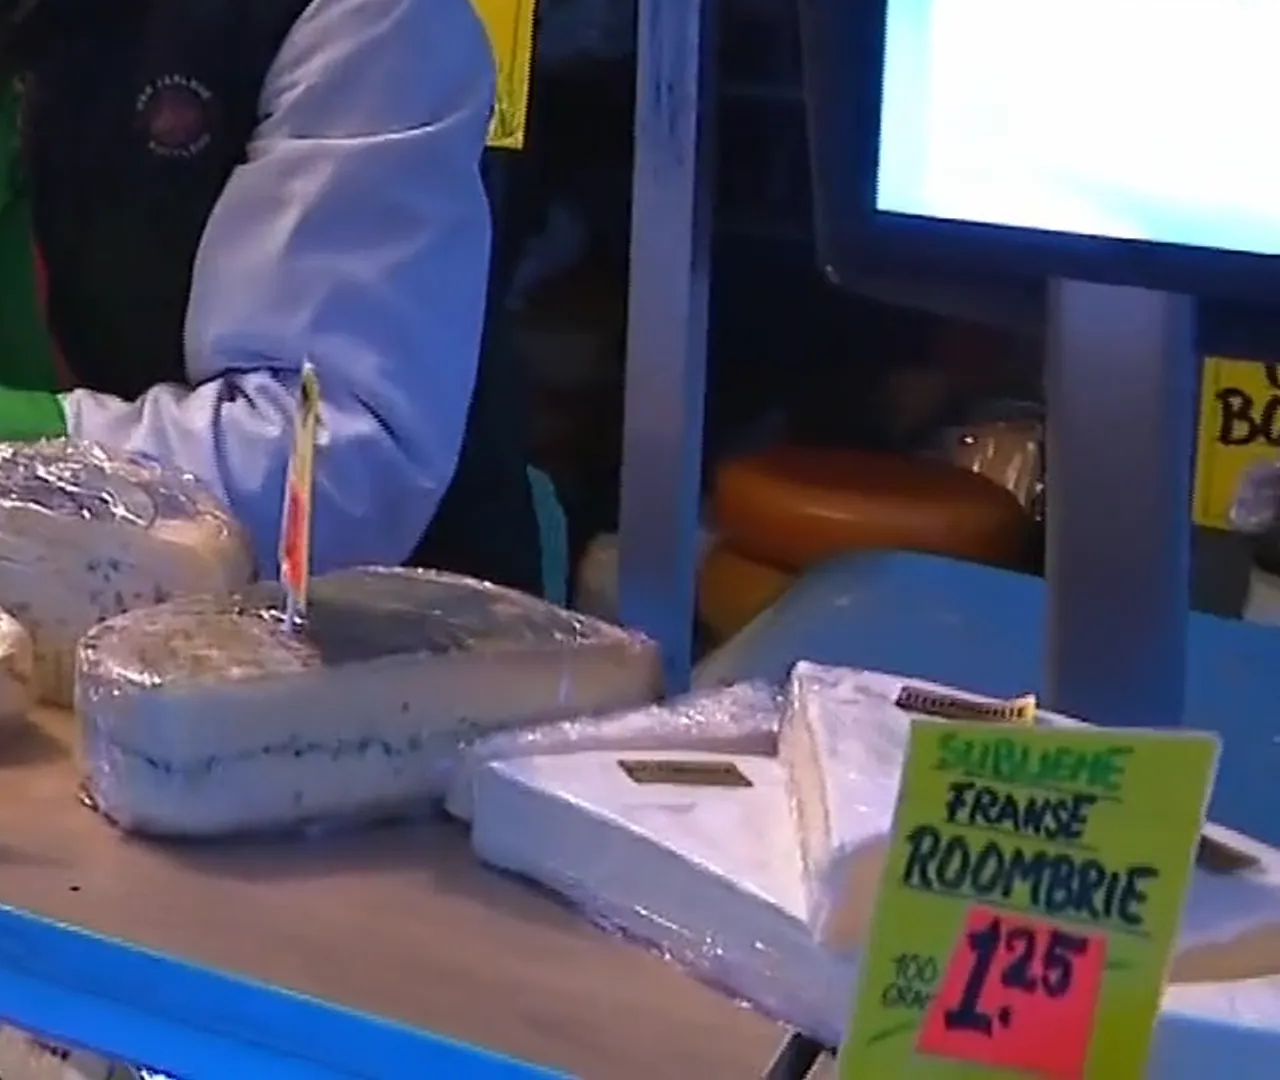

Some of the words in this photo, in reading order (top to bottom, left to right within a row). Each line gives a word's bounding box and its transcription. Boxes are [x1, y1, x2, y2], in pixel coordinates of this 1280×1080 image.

[946, 781, 1099, 840] FRANSE
[901, 825, 1161, 926] ROOMBRIE
[943, 915, 1090, 1038] 1.25
